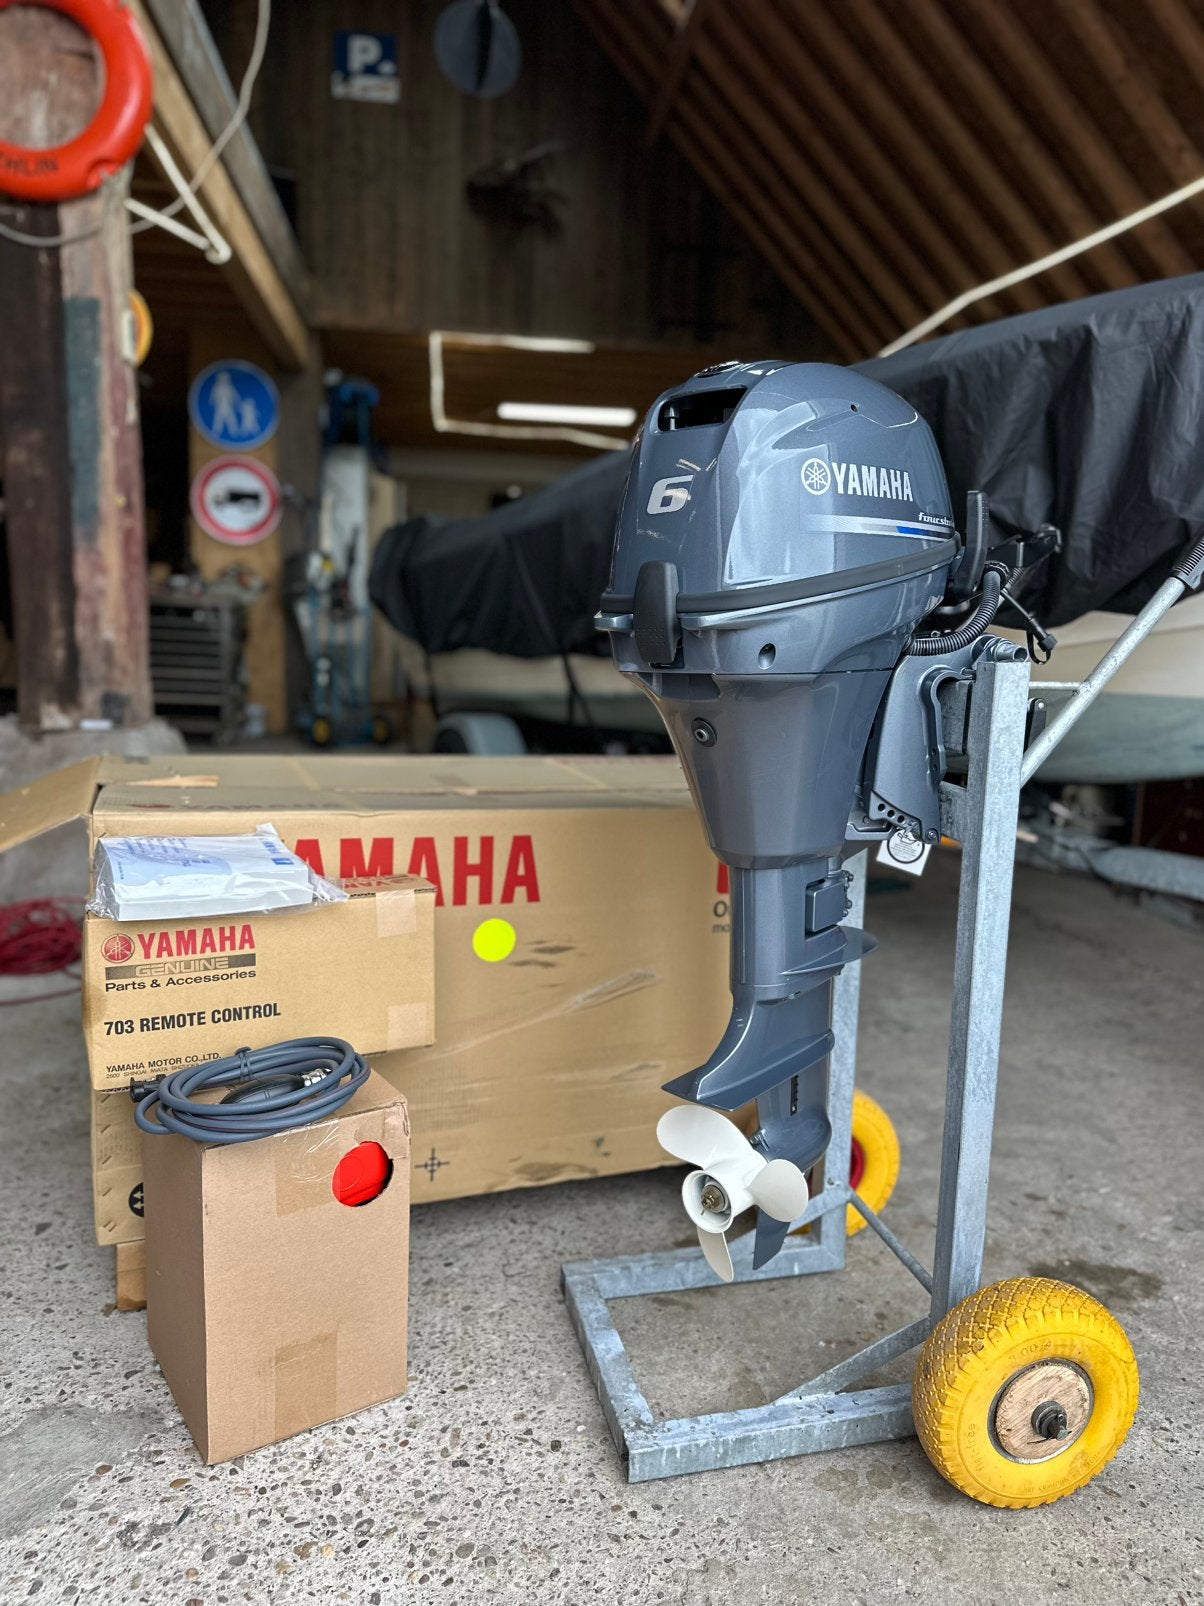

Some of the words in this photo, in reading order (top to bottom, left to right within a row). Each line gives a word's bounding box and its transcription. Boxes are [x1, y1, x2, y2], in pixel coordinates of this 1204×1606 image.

[646, 474, 694, 515] 6
[831, 461, 914, 502] YAMAHA
[293, 834, 541, 908] AMAHA
[137, 924, 255, 960] YAMAHA
[105, 980, 146, 992] Parts
[150, 979, 161, 988] &
[165, 969, 257, 987] Accessories
[135, 956, 229, 978] GENUINE
[104, 1019, 135, 1036] 703
[139, 1011, 206, 1033] REMOTE
[211, 1002, 281, 1024] CONTROL
[106, 1062, 145, 1073] YAMAHA
[148, 1057, 182, 1068] MOTOR
